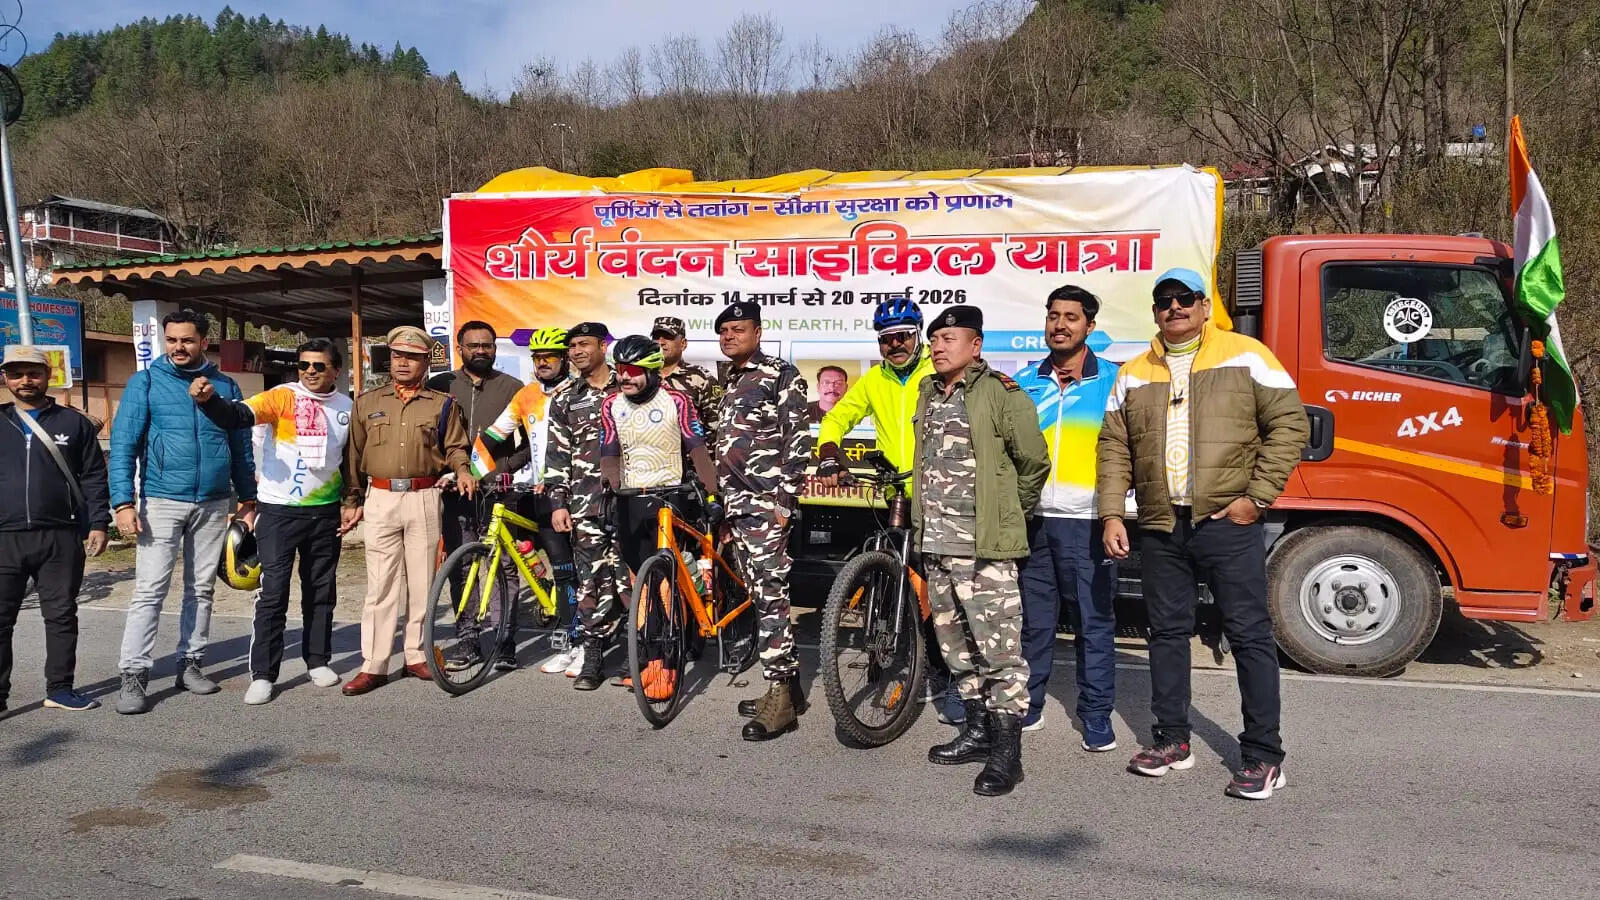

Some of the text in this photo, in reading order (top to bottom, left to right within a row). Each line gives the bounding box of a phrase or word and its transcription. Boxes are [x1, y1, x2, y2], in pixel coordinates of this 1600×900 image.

[663, 200, 683, 218] से
[688, 200, 749, 217] तवांग
[773, 196, 830, 216] सीमा
[834, 197, 900, 221] सुरक्षा
[904, 191, 940, 211] को
[944, 194, 1013, 212] प्रणाम
[486, 220, 1161, 282] शौर्य वंदन साइकिल यात्रा
[637, 287, 714, 306] दिनांक
[721, 291, 740, 306] 14
[746, 287, 798, 306] मार्च
[802, 287, 827, 306] से
[832, 289, 855, 305] 20
[918, 288, 967, 305] 2026
[30, 301, 76, 317] HOMESTAY
[425, 311, 449, 323] BUS
[134, 325, 157, 337] BUS
[762, 318, 783, 331] ON
[789, 318, 847, 332] EARTH,
[1011, 335, 1048, 350] CRE
[1351, 390, 1402, 402] EICHER
[1396, 406, 1464, 438] 4X4
